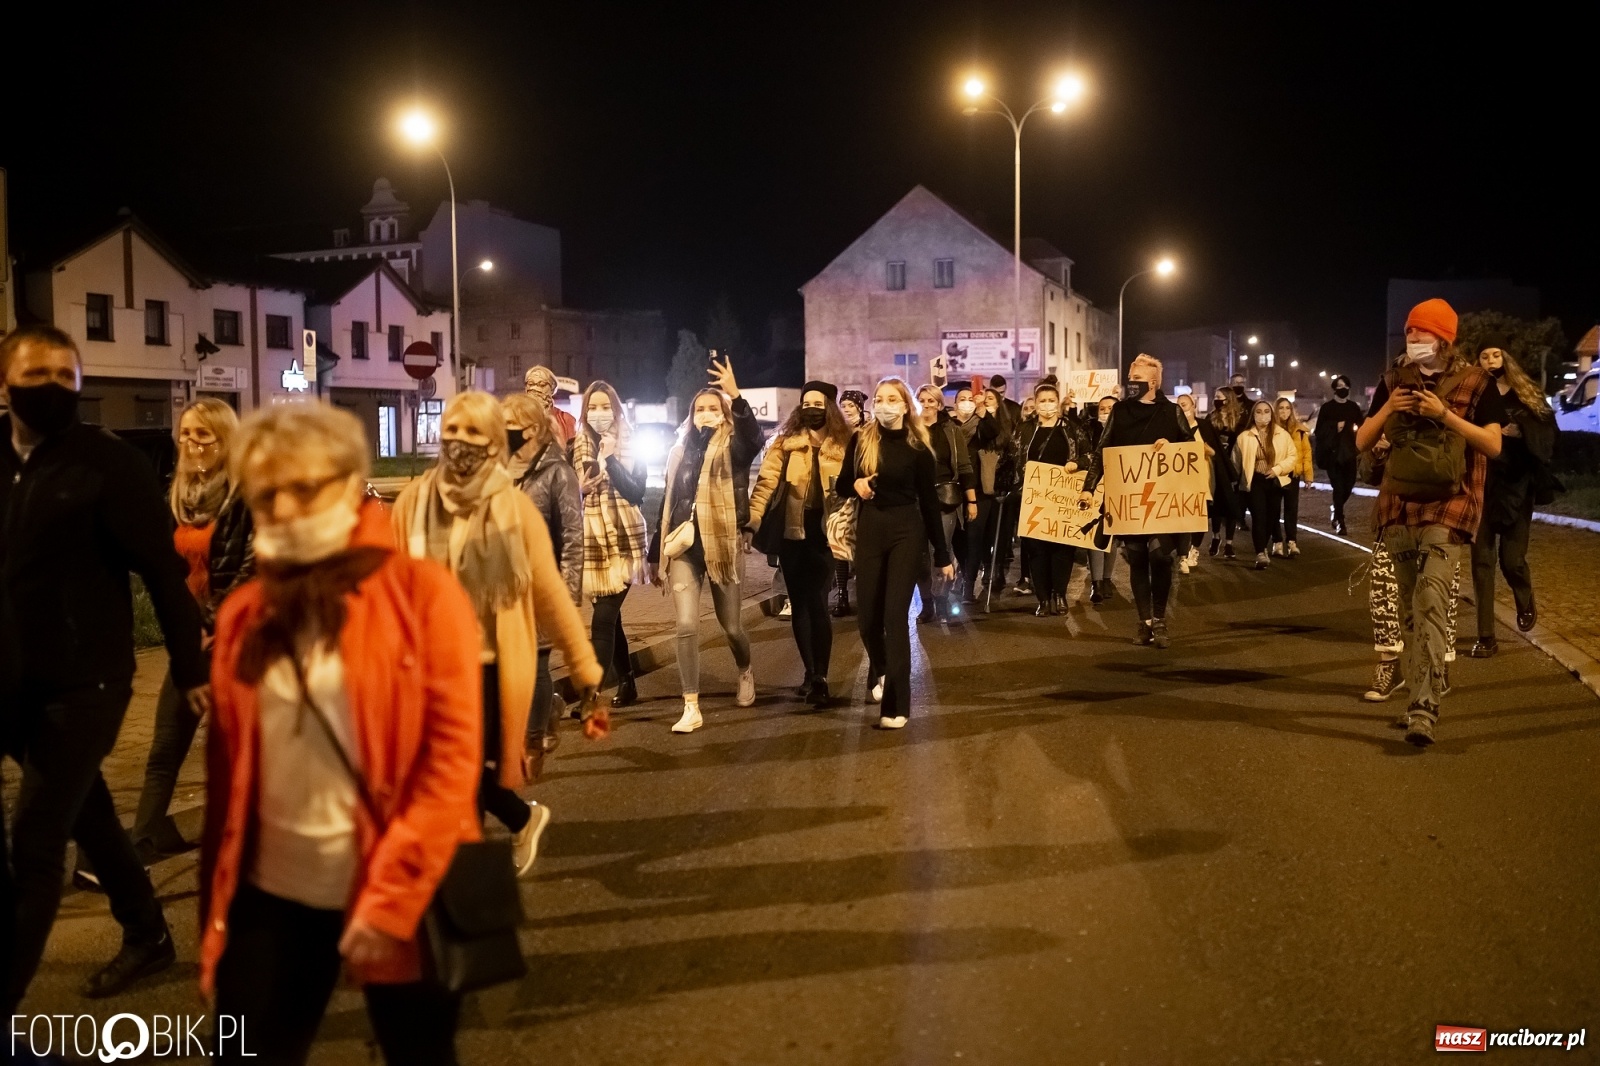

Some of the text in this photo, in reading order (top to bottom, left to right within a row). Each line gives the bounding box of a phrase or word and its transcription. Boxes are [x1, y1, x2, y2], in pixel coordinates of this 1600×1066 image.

[1028, 465, 1041, 485] A
[1119, 448, 1200, 484] WYBÓR
[1108, 491, 1208, 521] NIE ZAKAZ
[1040, 517, 1058, 538] JA
